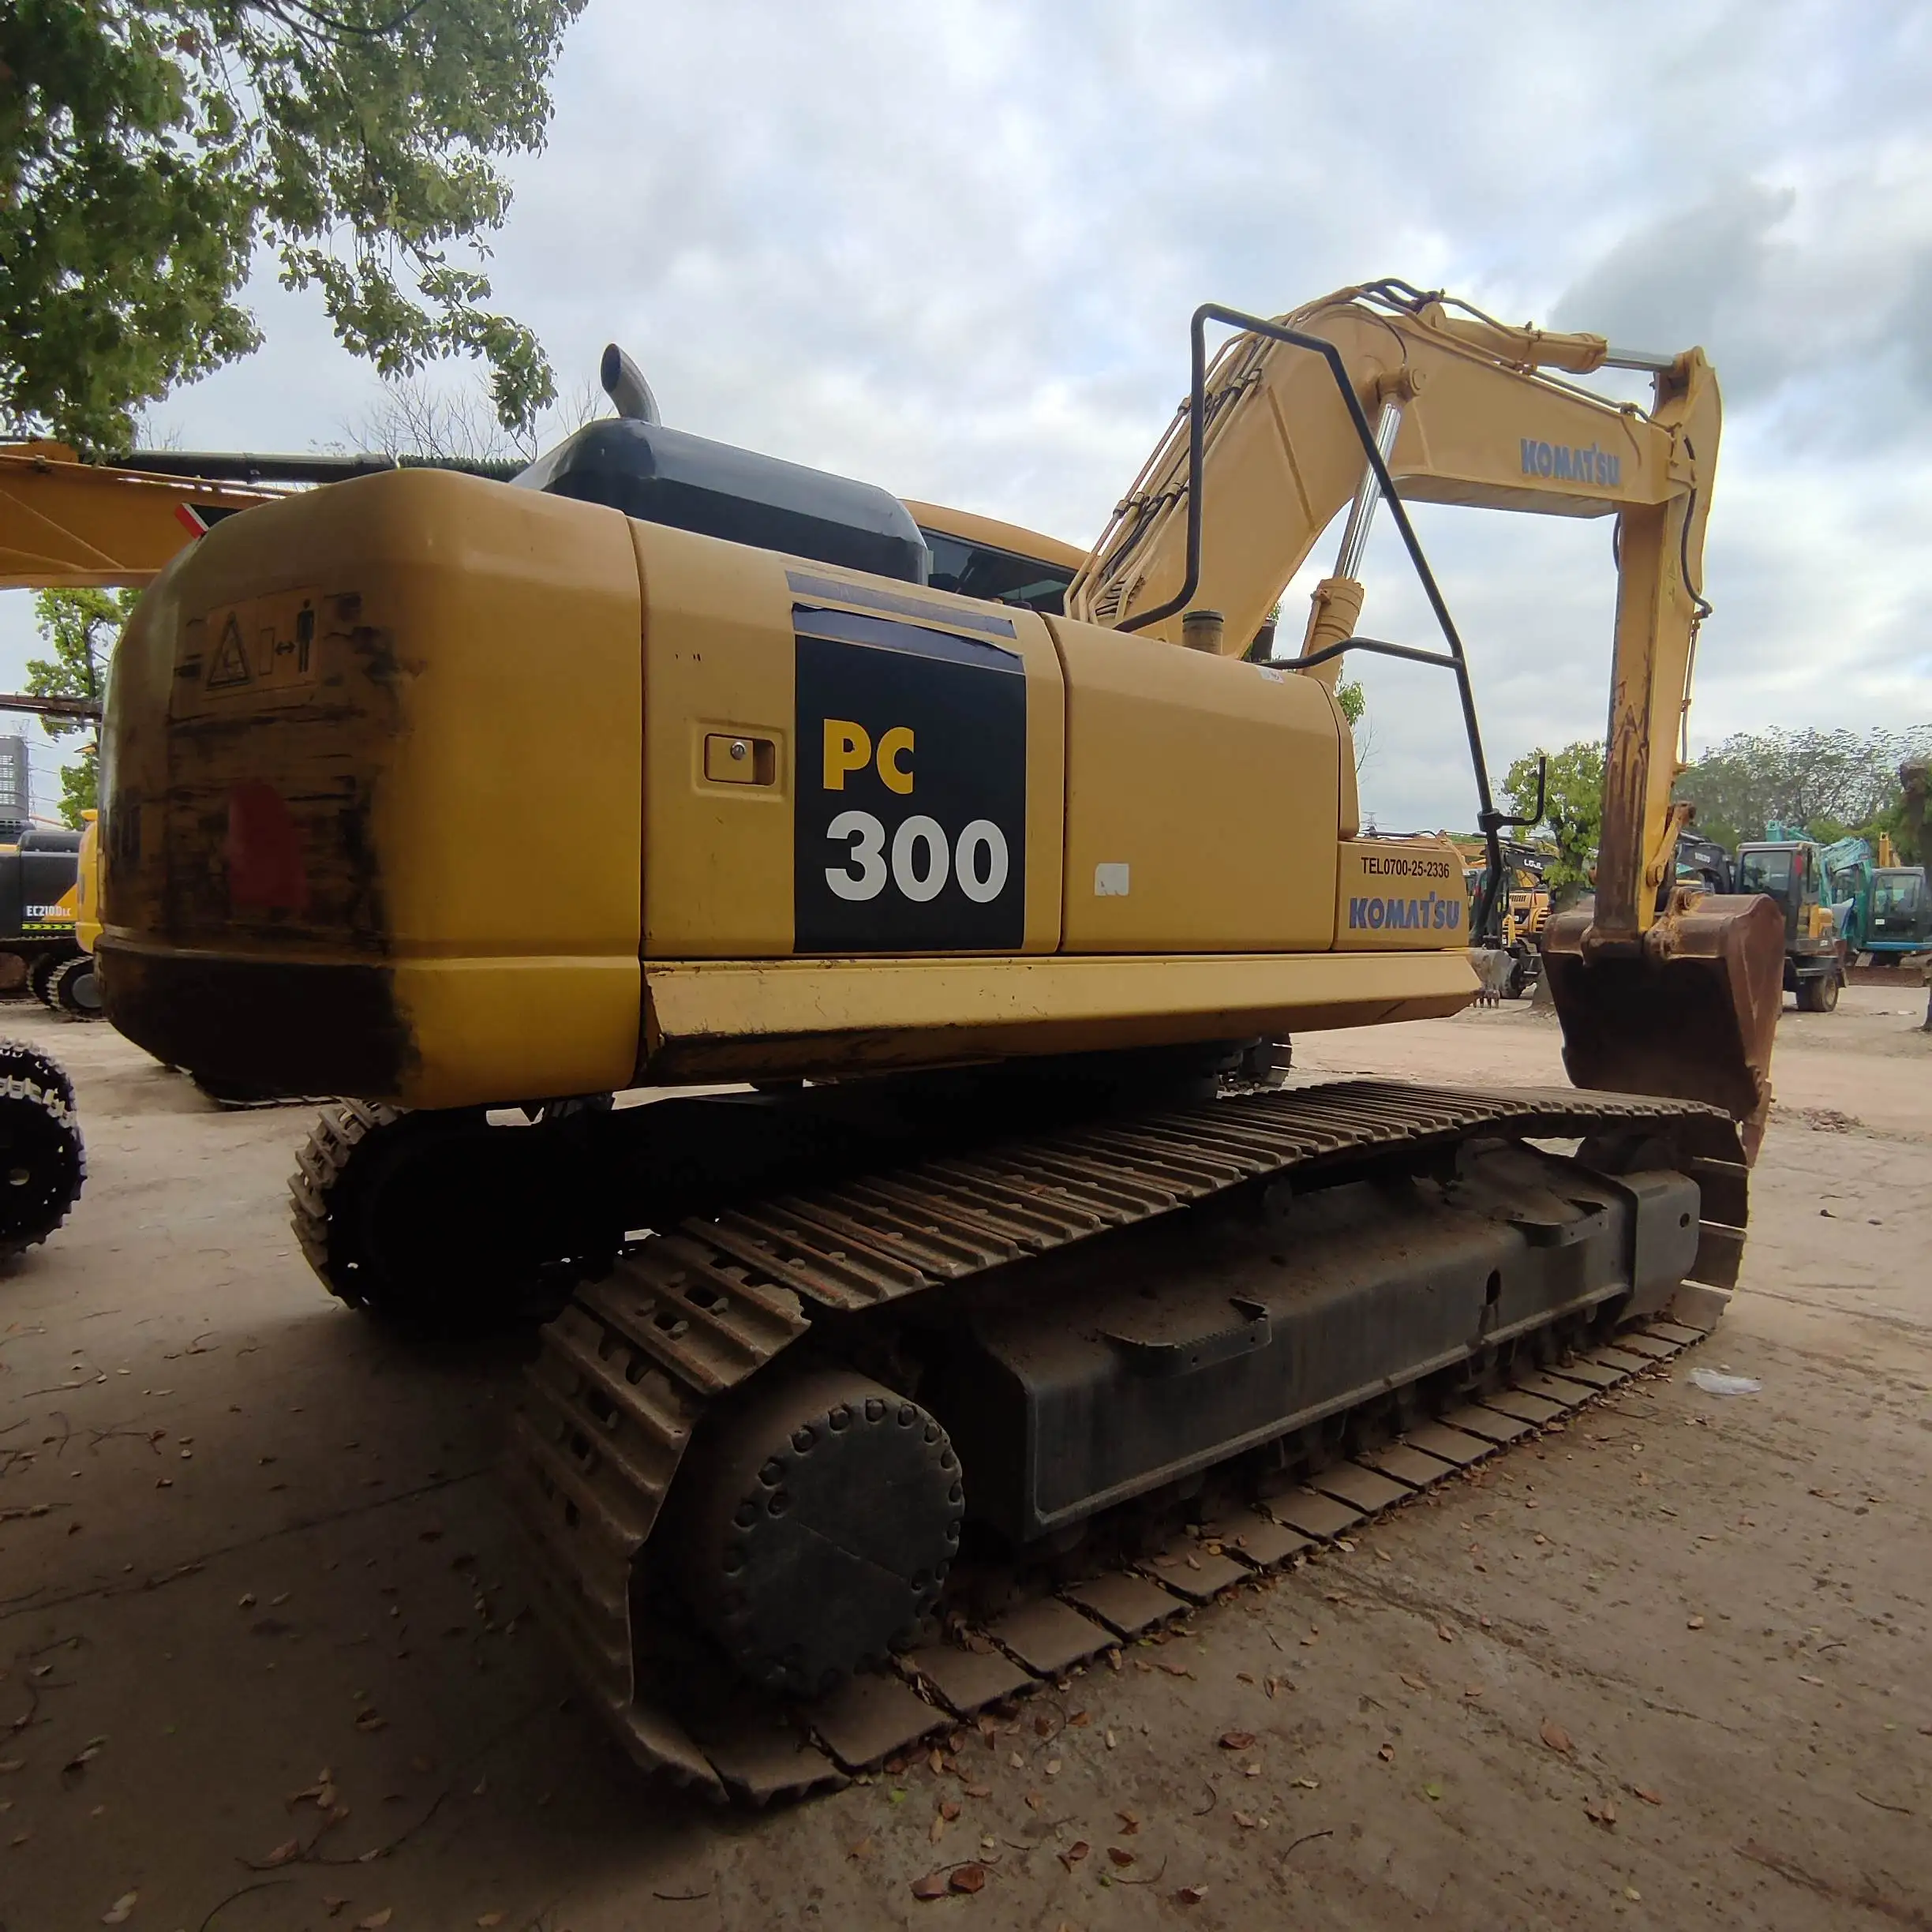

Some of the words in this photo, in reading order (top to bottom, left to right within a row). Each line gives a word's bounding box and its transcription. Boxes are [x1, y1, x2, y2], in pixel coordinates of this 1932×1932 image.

[1520, 437, 1621, 486] KOMATSU
[823, 718, 915, 795] PC
[825, 810, 1009, 904] 300
[1361, 856, 1451, 878] TEL0700-25-2336
[1349, 890, 1460, 930] KOMATSU
